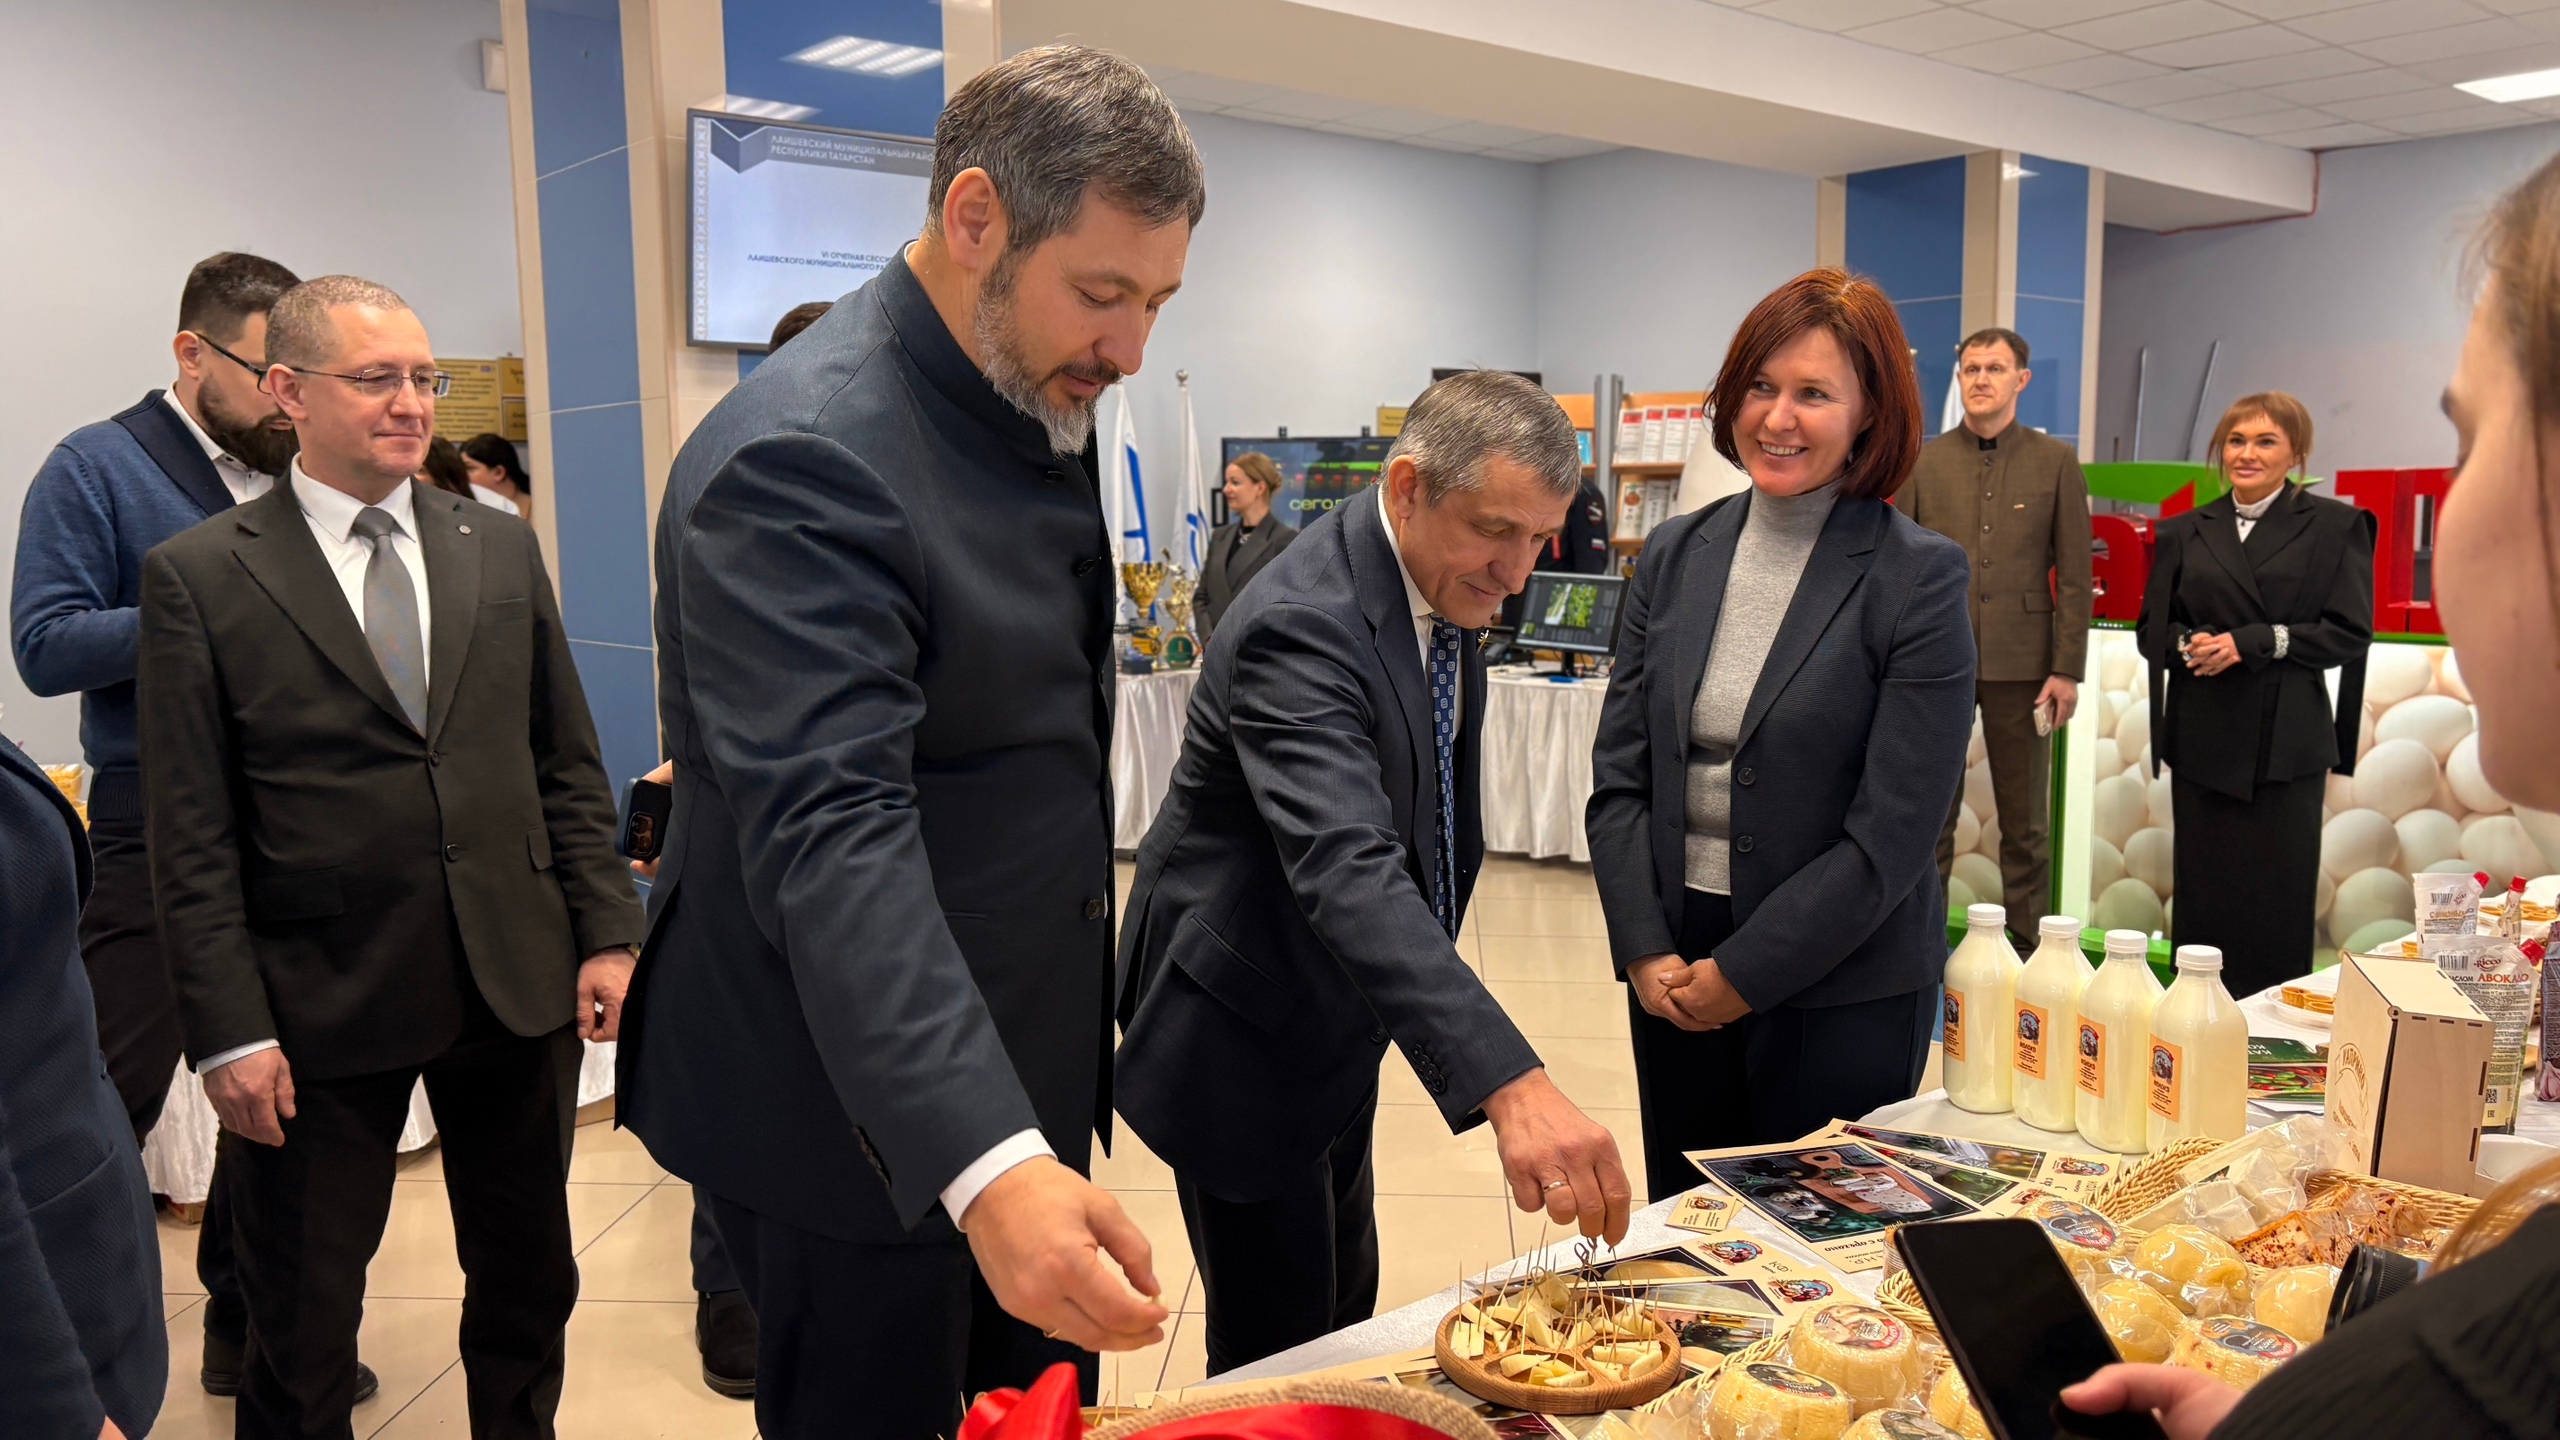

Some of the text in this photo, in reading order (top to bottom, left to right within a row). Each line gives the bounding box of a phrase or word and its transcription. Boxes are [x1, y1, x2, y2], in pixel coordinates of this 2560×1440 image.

[771, 145, 875, 165] РЕСПУБЛИКИ ТАТАРСТАН
[833, 142, 910, 158] МУНИЦИПАЛЬНЫЙ
[911, 150, 934, 162] РАЙО
[748, 254, 805, 265] ЛАИШЕВСКОГО
[806, 258, 875, 271] МУНИЦИПАЛЬНОГО
[830, 252, 864, 262] ОТЧЕТНАЯ
[866, 254, 892, 263] СЕССИ
[1289, 498, 1344, 511] сего
